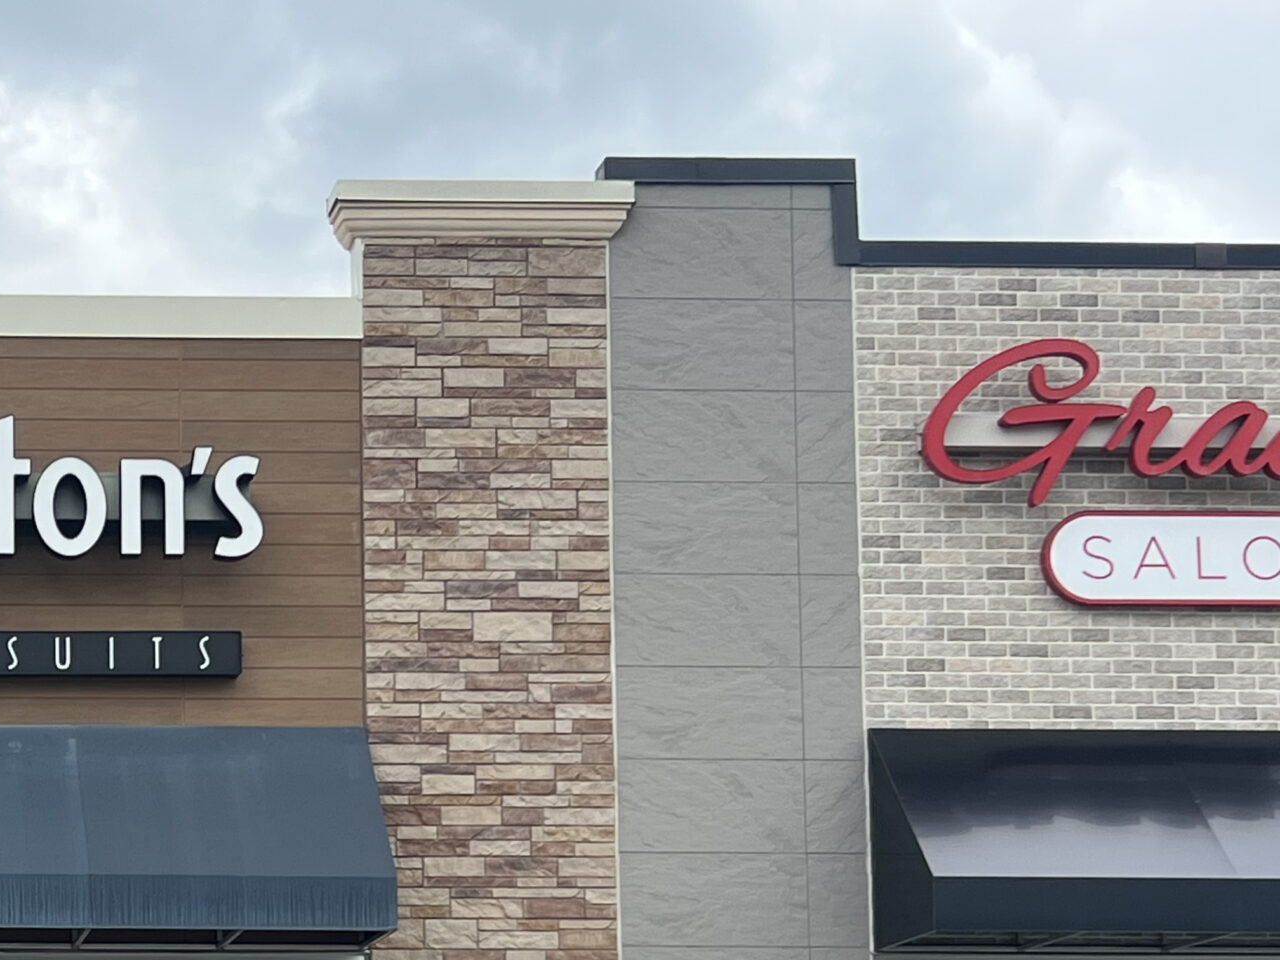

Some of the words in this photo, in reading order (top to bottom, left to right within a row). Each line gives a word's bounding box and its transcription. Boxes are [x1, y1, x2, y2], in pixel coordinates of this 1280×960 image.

[922, 338, 1280, 508] Gra
[1082, 535, 1280, 580] SALO
[7, 636, 210, 670] SUITS
